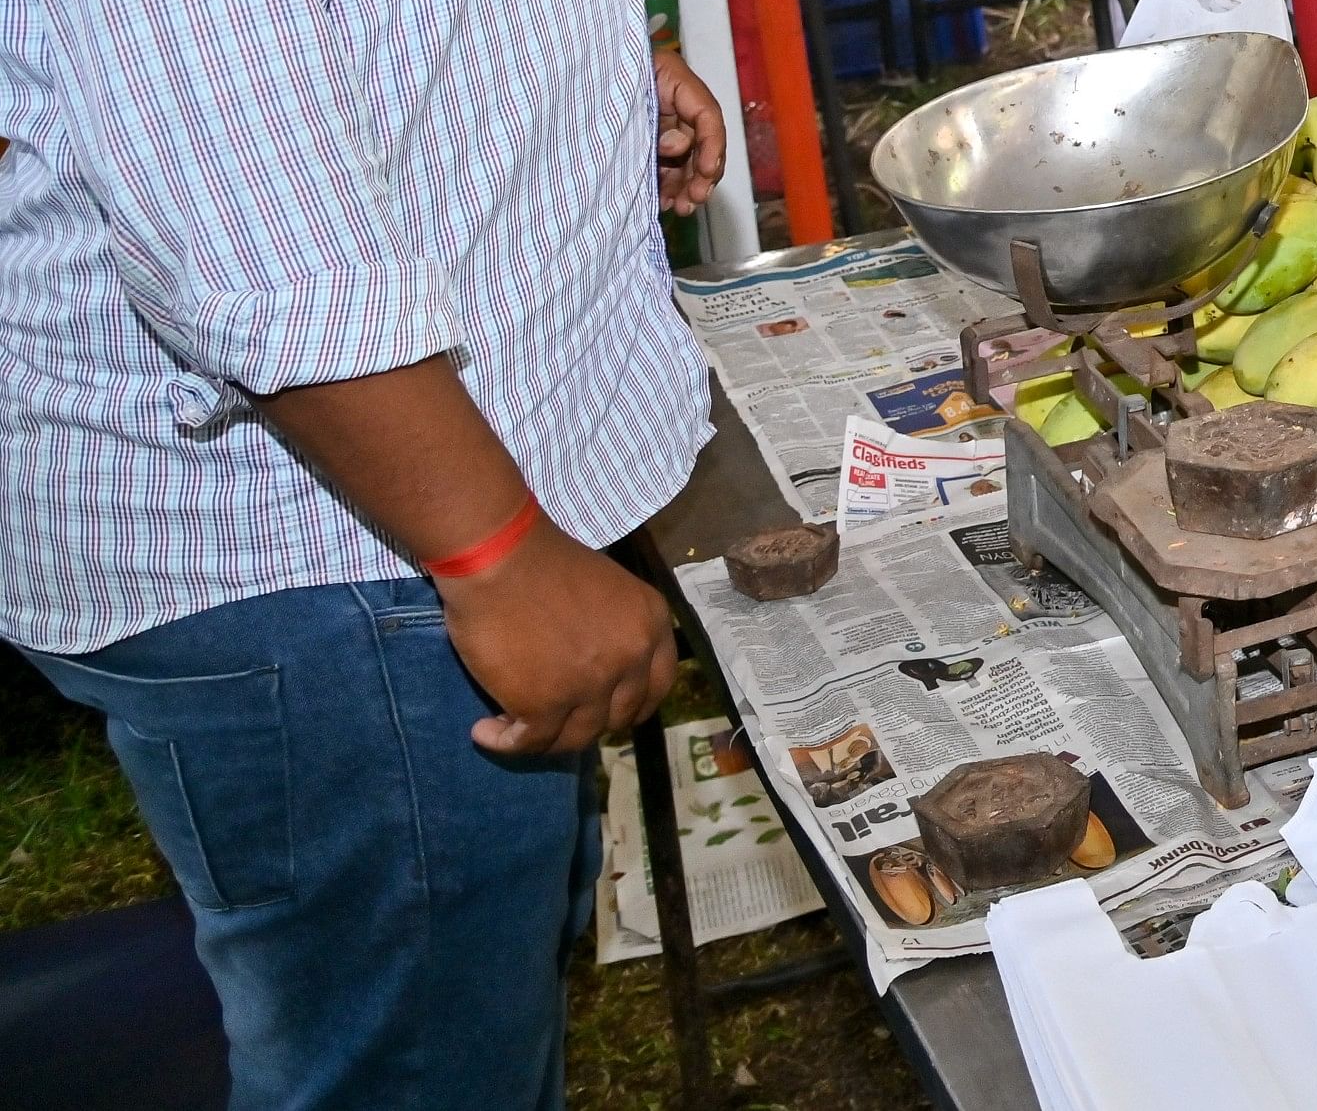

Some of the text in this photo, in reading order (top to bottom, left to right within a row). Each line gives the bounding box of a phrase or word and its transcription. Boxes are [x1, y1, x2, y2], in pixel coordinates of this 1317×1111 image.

[983, 619, 1062, 646] WELLNSS
[1003, 697, 1048, 721] Baroque
[1041, 710, 1056, 721] on
[995, 716, 1060, 747] majestically
[1023, 717, 1041, 730] the
[1028, 721, 1064, 741] Sitting
[828, 781, 908, 817] Bavaria
[1147, 840, 1201, 870] DRINK
[1215, 838, 1260, 857] FOOD
